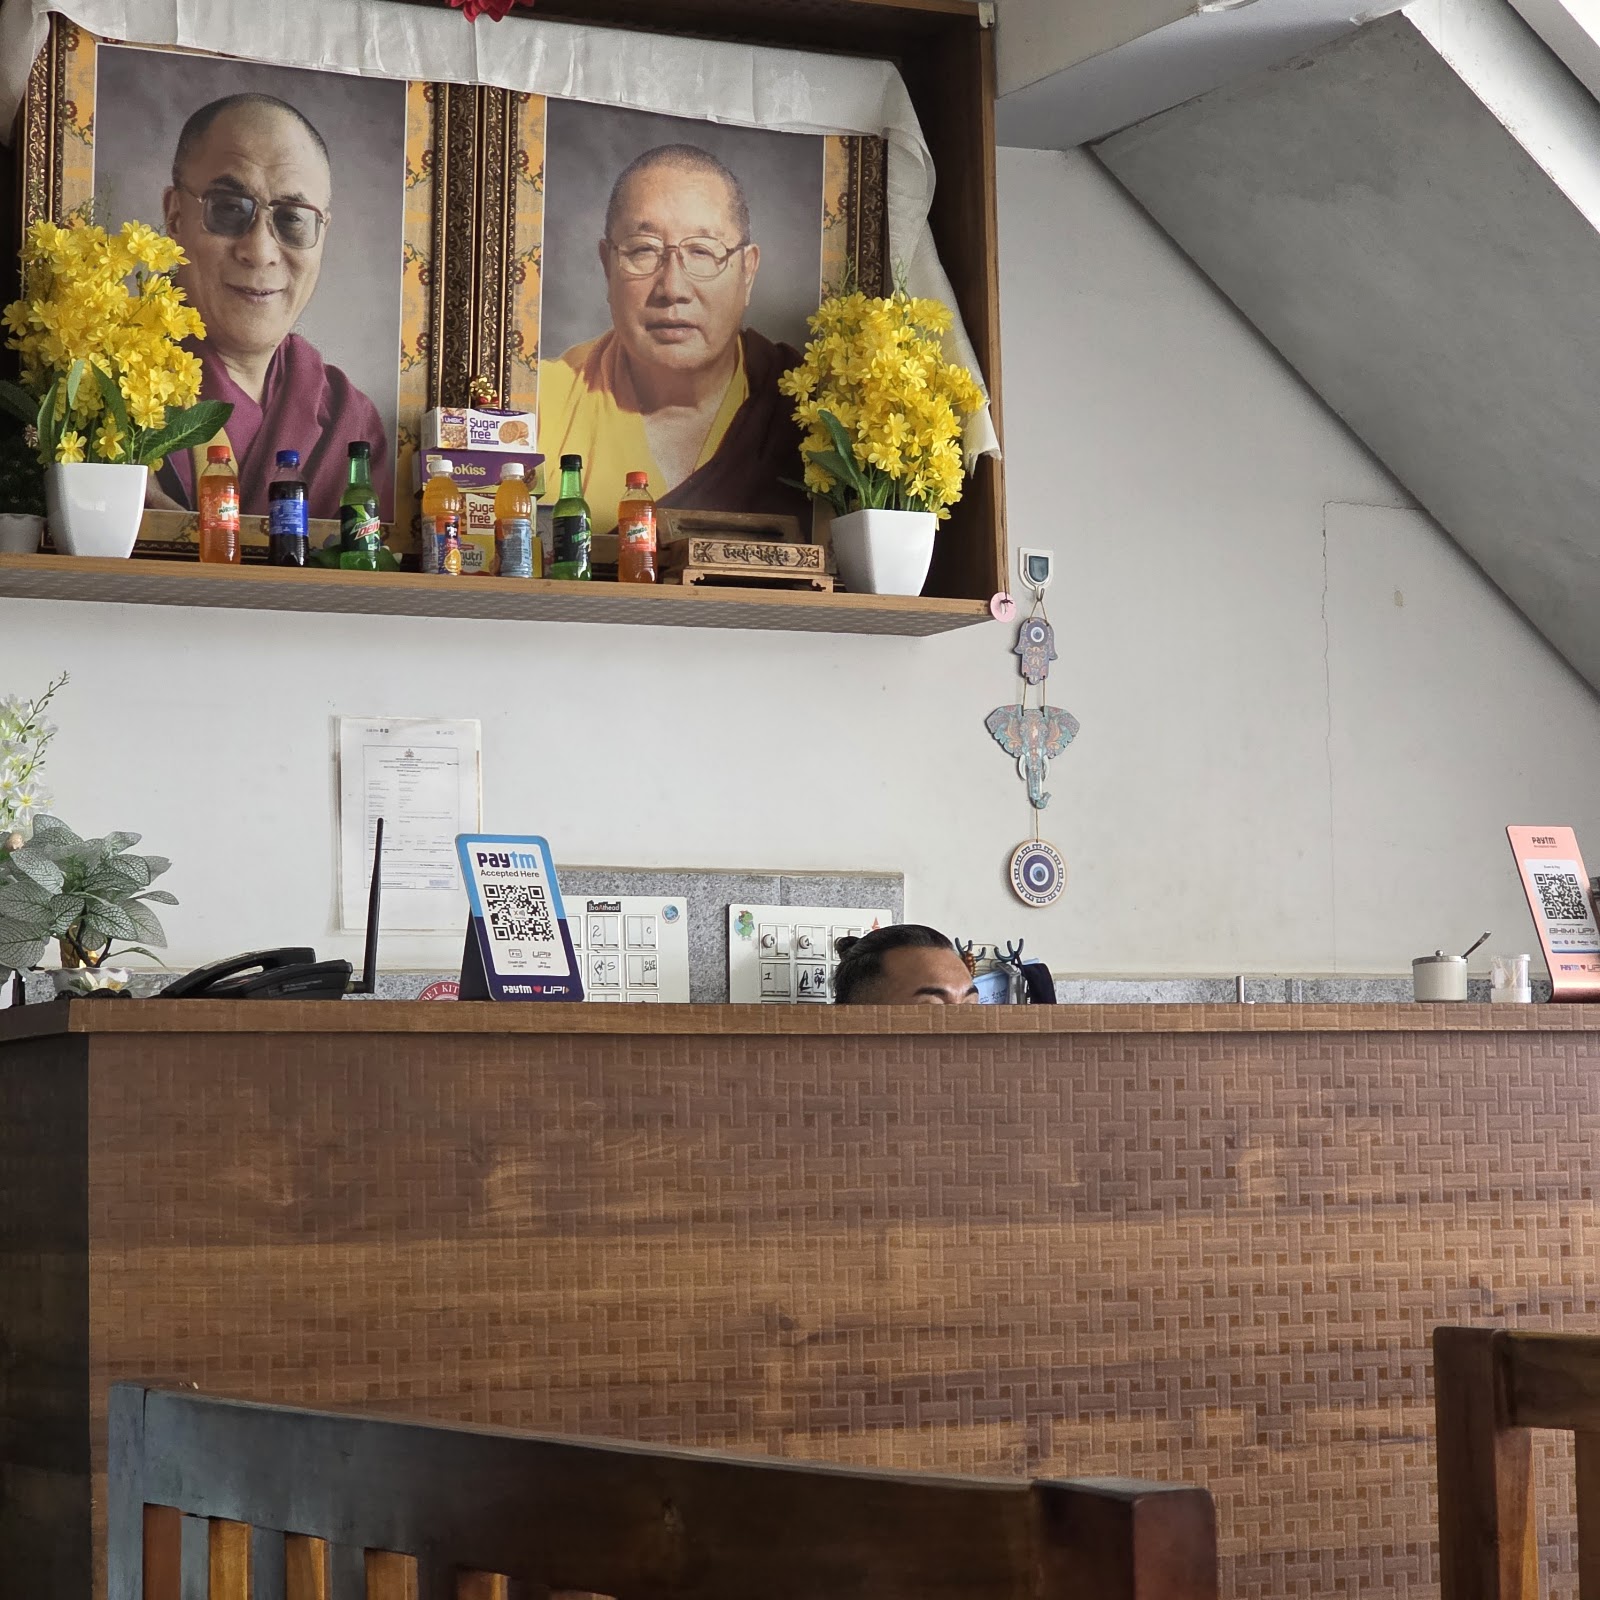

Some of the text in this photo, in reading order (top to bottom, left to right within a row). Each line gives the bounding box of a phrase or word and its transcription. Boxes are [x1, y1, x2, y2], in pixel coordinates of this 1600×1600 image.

[469, 418, 500, 431] Sugar
[470, 428, 491, 439] free
[469, 502, 494, 514] Suga
[470, 514, 490, 524] free
[481, 869, 519, 878] Accepted
[593, 925, 601, 938] 2
[543, 985, 565, 994] UPI
